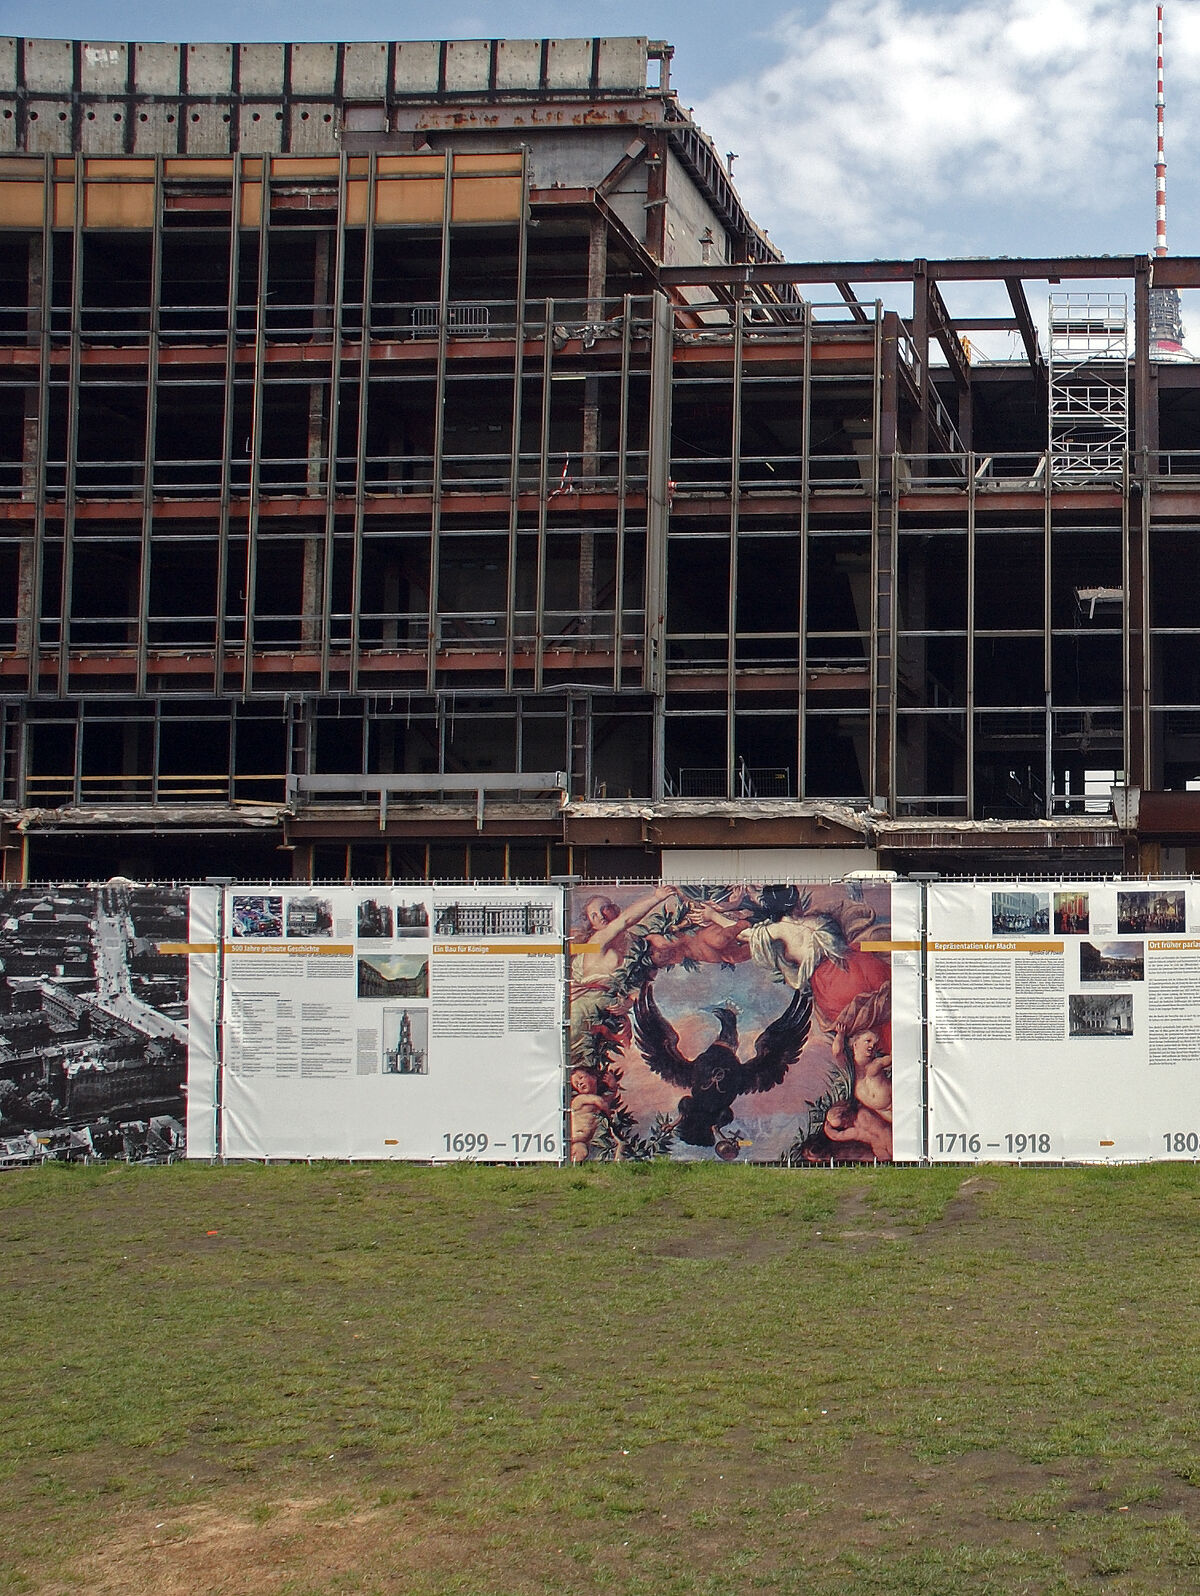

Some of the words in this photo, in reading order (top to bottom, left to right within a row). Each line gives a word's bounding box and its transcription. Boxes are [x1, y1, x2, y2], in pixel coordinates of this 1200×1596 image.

[231, 944, 243, 952] 500
[243, 944, 260, 952] Jahre
[261, 944, 286, 954] gebaute
[287, 944, 320, 952] Geschichte
[934, 942, 984, 951] Repräsentation
[1149, 941, 1160, 949] Ort
[1161, 940, 1181, 948] früher
[434, 945, 444, 953] Ein
[444, 945, 456, 953] Bau
[457, 945, 467, 953] für
[467, 945, 489, 955] Könige
[442, 1133, 489, 1153] 1699
[511, 1133, 556, 1153] 1716
[935, 1133, 981, 1153] 1716
[1004, 1133, 1051, 1153] 1918
